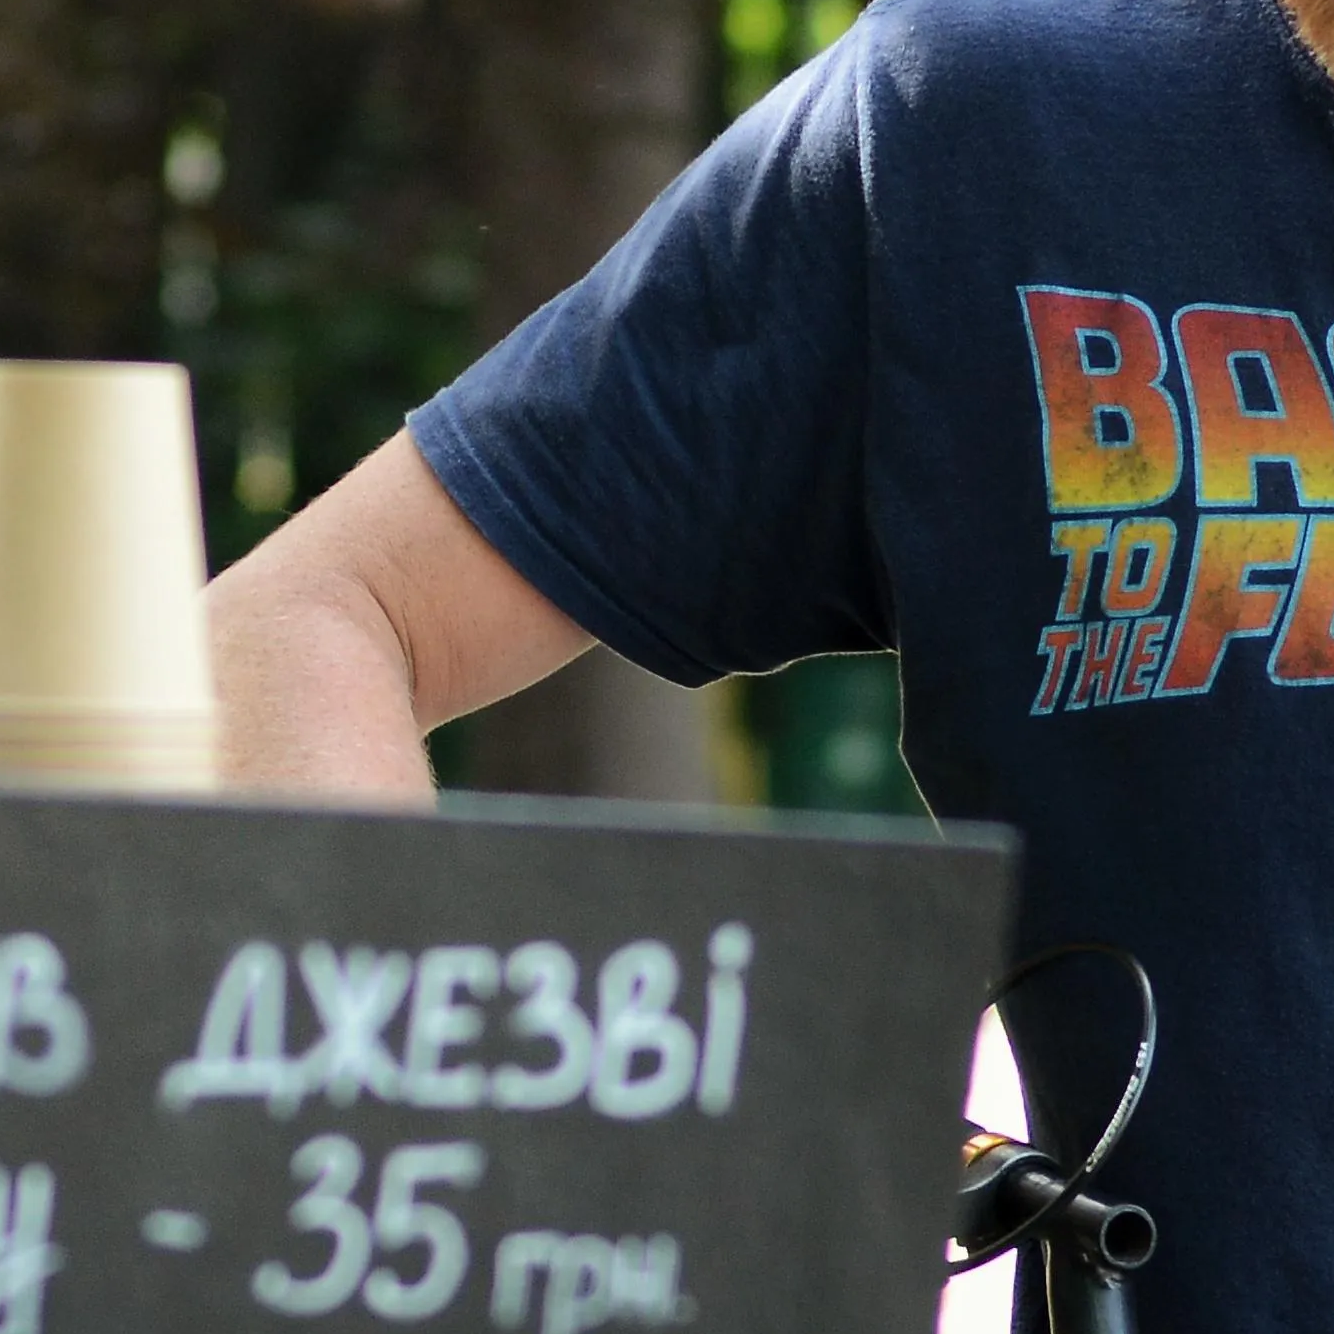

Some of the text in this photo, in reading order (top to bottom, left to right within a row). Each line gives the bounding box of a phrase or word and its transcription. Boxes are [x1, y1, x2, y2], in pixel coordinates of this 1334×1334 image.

[1050, 516, 1178, 621] TO
[1029, 614, 1171, 716] THE
[251, 1132, 484, 1321] 35
